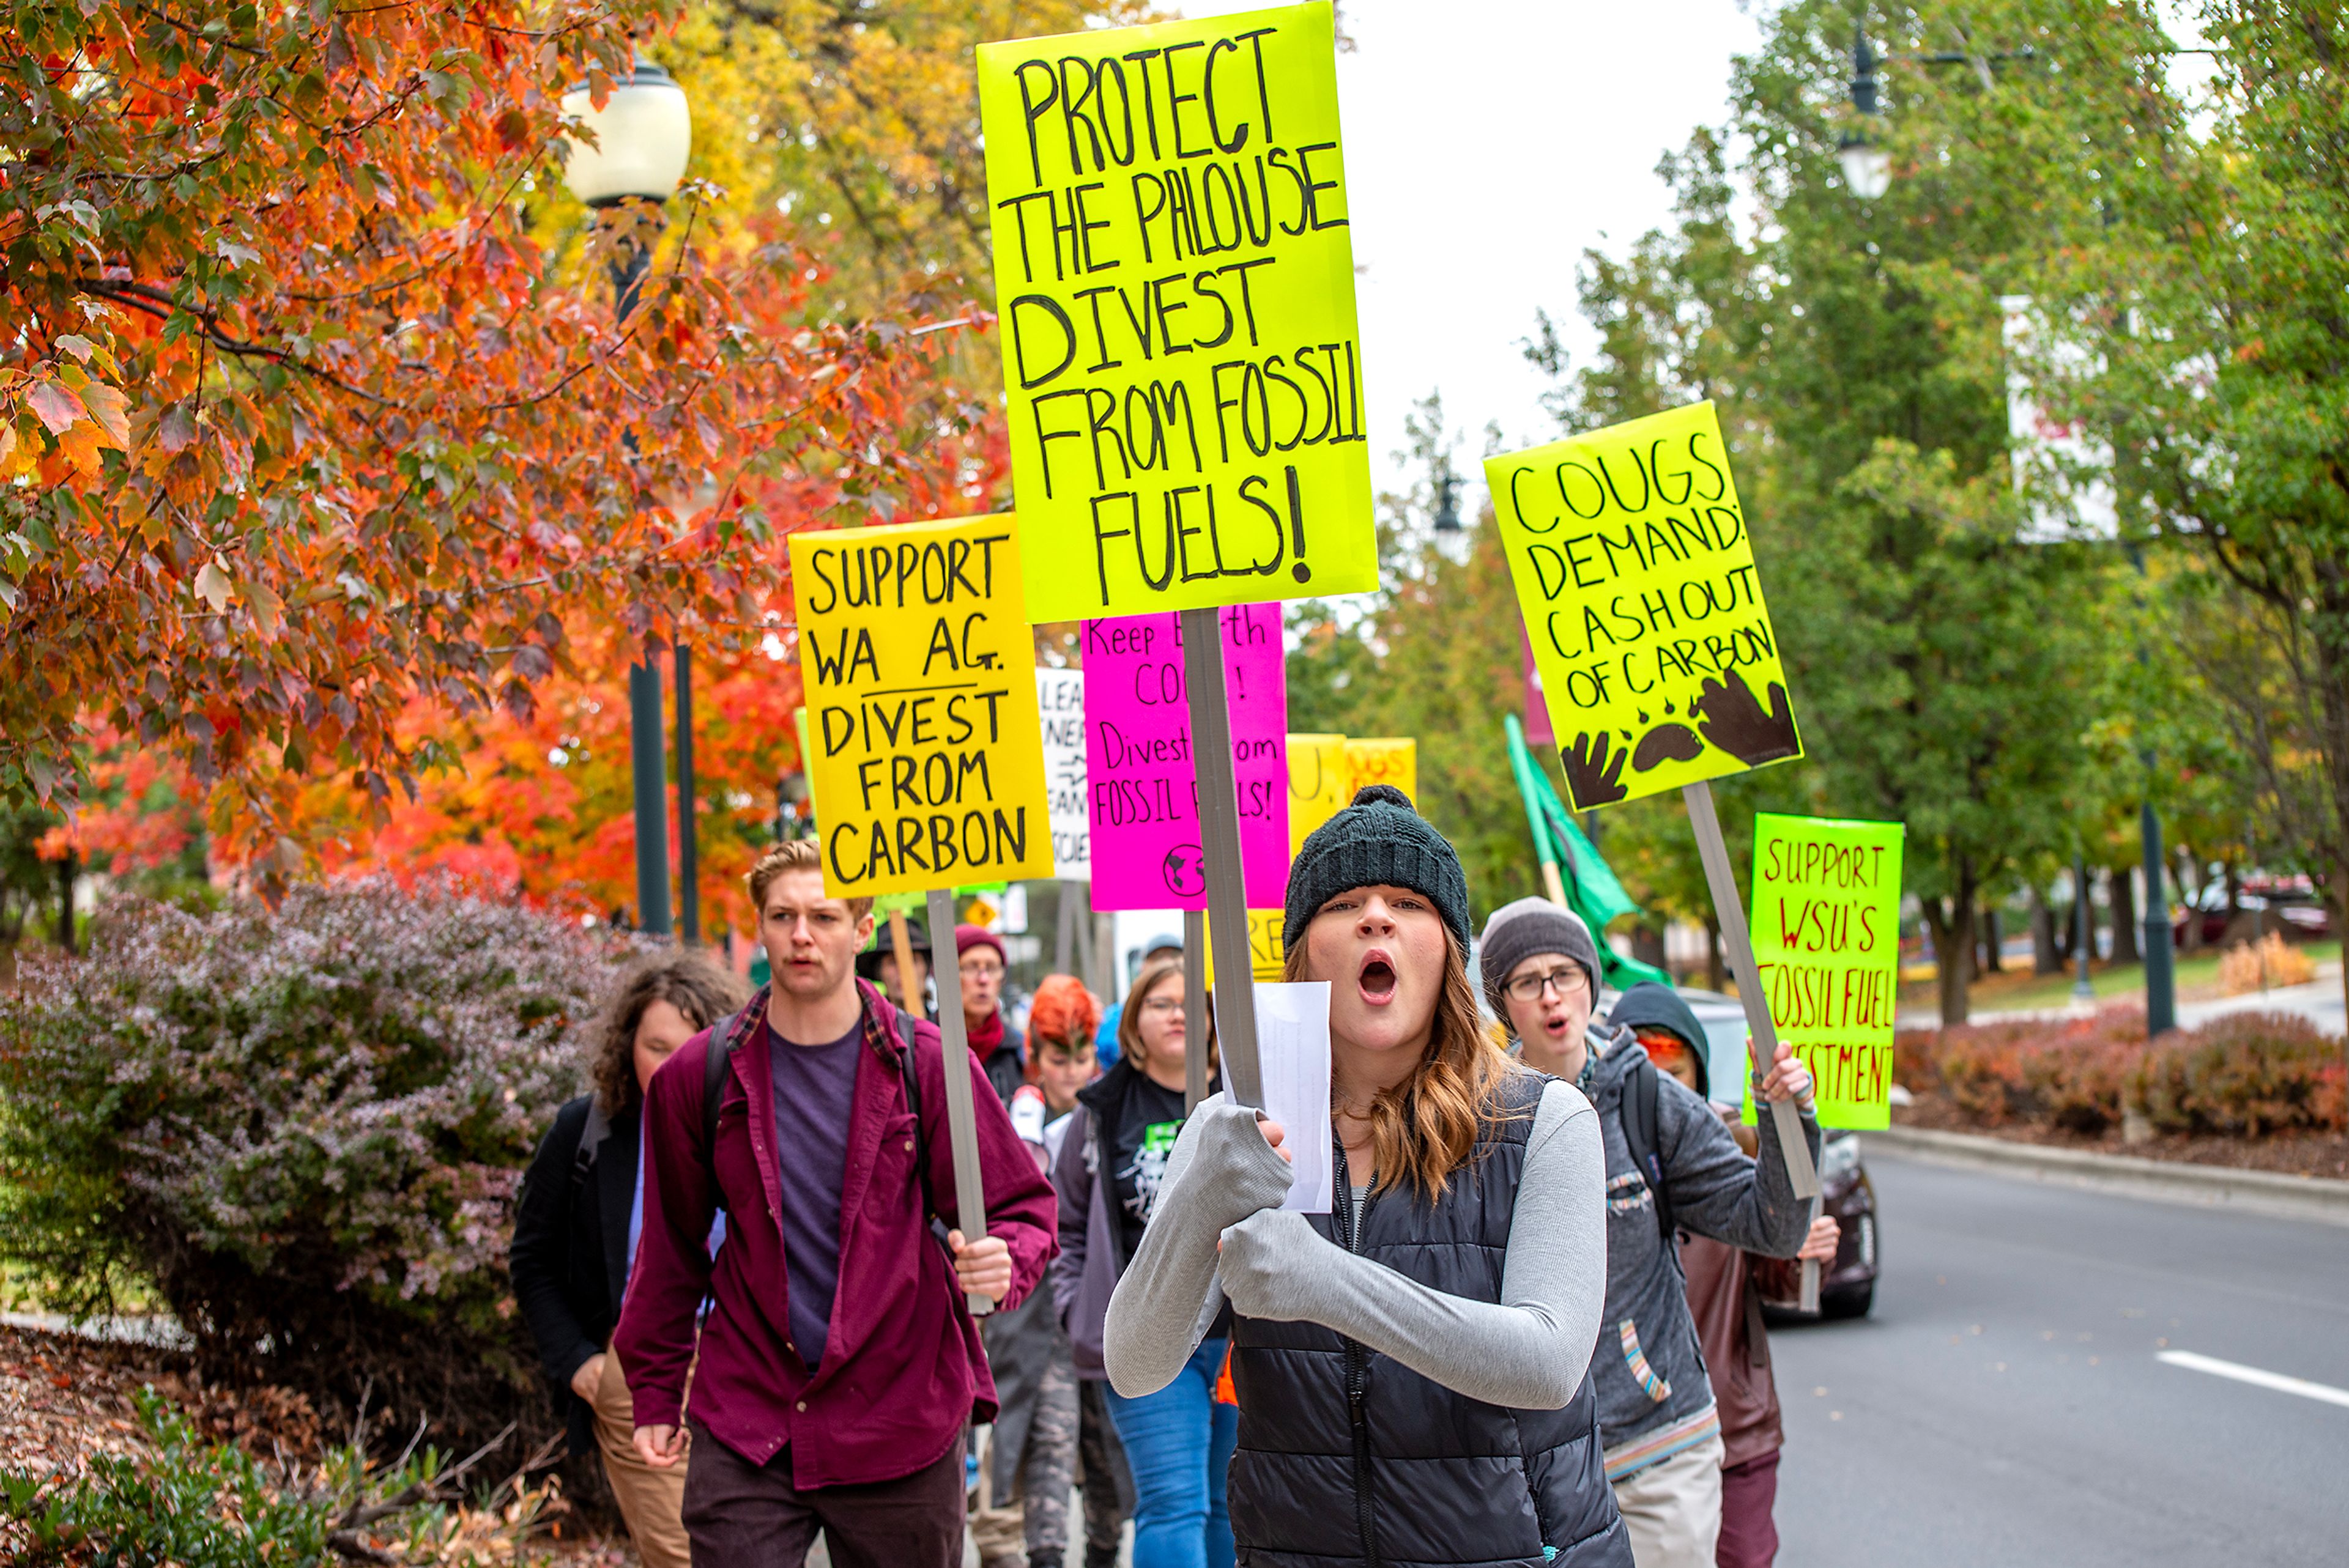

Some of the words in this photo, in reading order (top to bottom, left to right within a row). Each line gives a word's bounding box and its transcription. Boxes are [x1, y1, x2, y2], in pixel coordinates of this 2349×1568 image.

[1014, 28, 1275, 188] PROTECT
[997, 182, 1120, 283] THE
[1131, 141, 1349, 264] PALOUSE
[1009, 257, 1274, 390] DIVEST
[1031, 380, 1203, 500] FROM
[1211, 341, 1366, 464] FOSSIL
[1511, 433, 1724, 533] COUGS
[1089, 465, 1312, 606] FUELS!
[1527, 503, 1748, 601] DEMAND:
[809, 534, 1010, 615] SUPPORT
[807, 627, 880, 686] WA
[922, 612, 1004, 676] AG.
[1088, 618, 1154, 655] Keep
[1173, 604, 1267, 646] Eth
[1567, 661, 1610, 708] OF
[1622, 619, 1773, 693] CARBON
[1136, 663, 1245, 705] CO!
[822, 689, 1009, 758] DIVEST
[1100, 721, 1189, 769] Divest
[1236, 740, 1277, 761] om
[858, 750, 993, 811] FROM
[1096, 778, 1182, 826] FOSSIL
[1191, 780, 1272, 821] FLS!
[829, 806, 1026, 884] CARBON
[1765, 838, 1885, 889] SUPPORT
[1780, 896, 1877, 952] WSU'S
[1842, 968, 1893, 1029] FUEL
